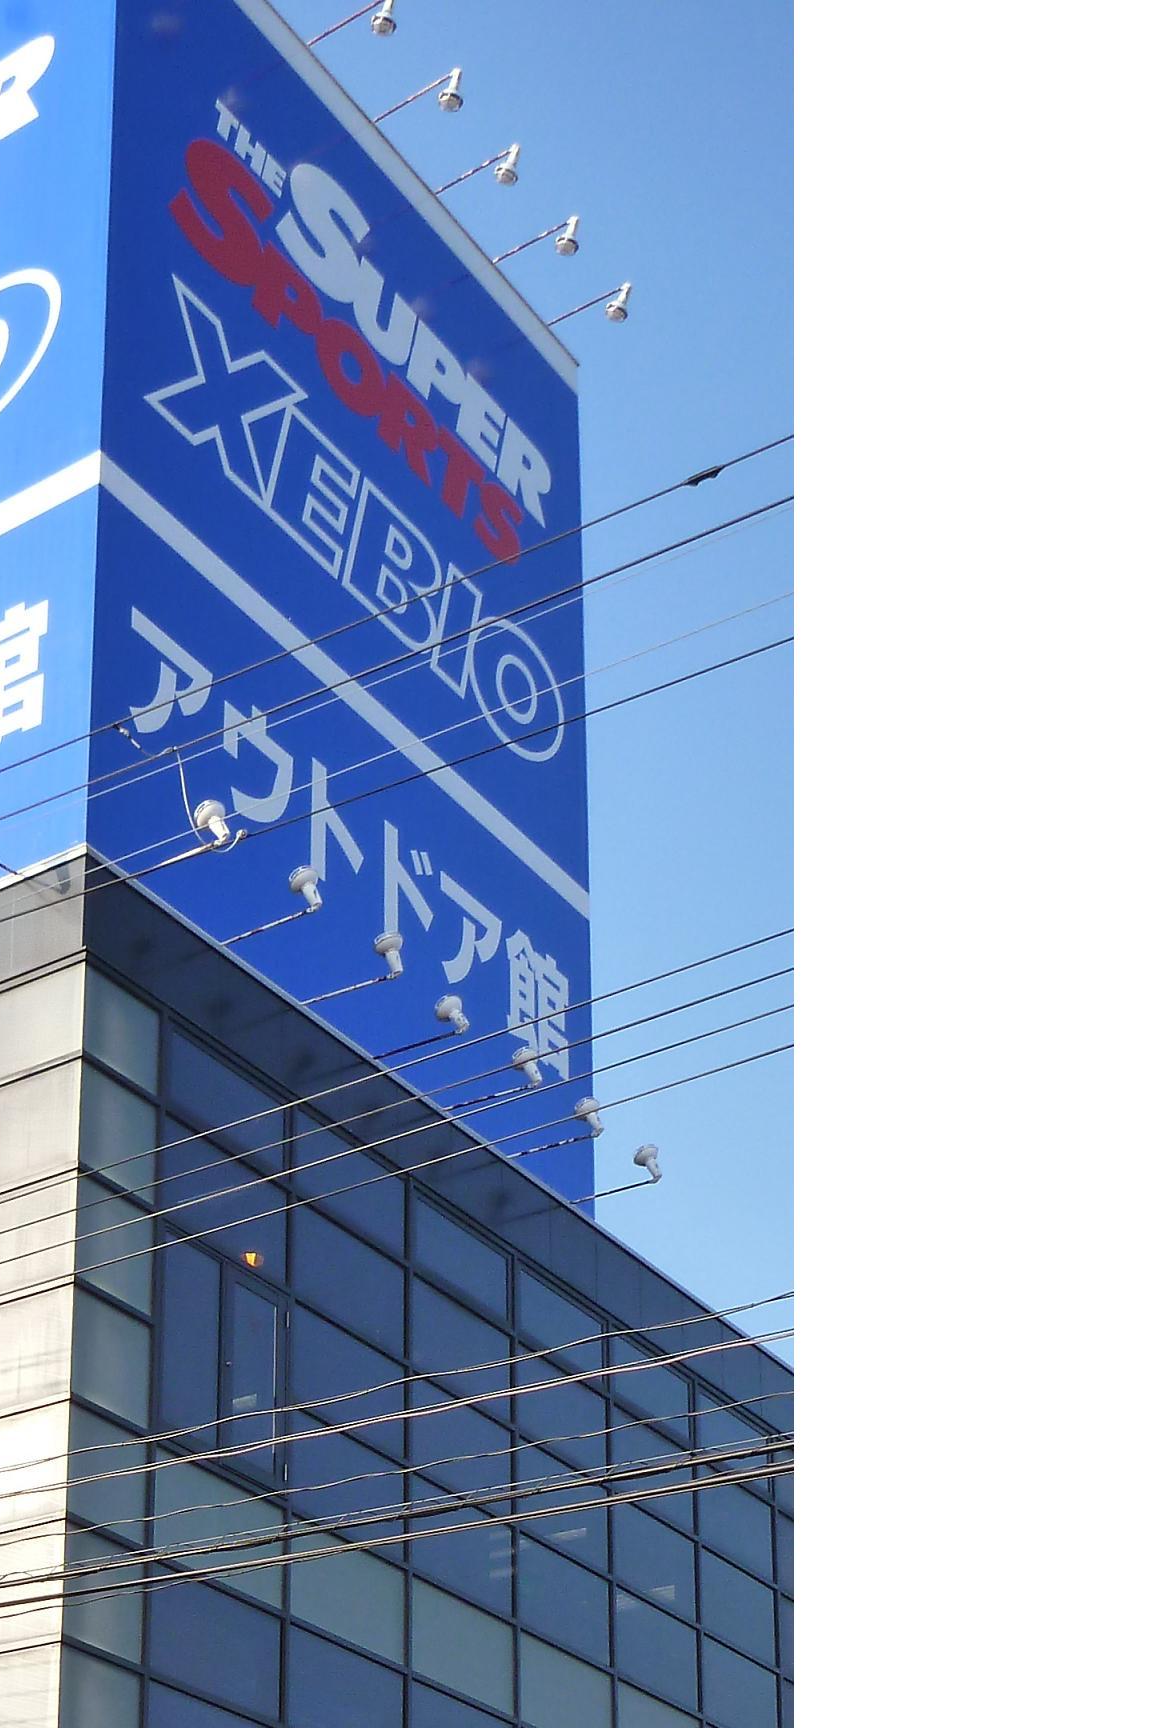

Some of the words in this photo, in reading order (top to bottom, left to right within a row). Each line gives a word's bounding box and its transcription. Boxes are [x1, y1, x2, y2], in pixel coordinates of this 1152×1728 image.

[144, 273, 565, 762] XEBIO
[169, 139, 524, 566] SPORTS
[215, 98, 288, 198] THE
[275, 163, 551, 529] SUPER
[129, 606, 570, 1081] アウトドア館
